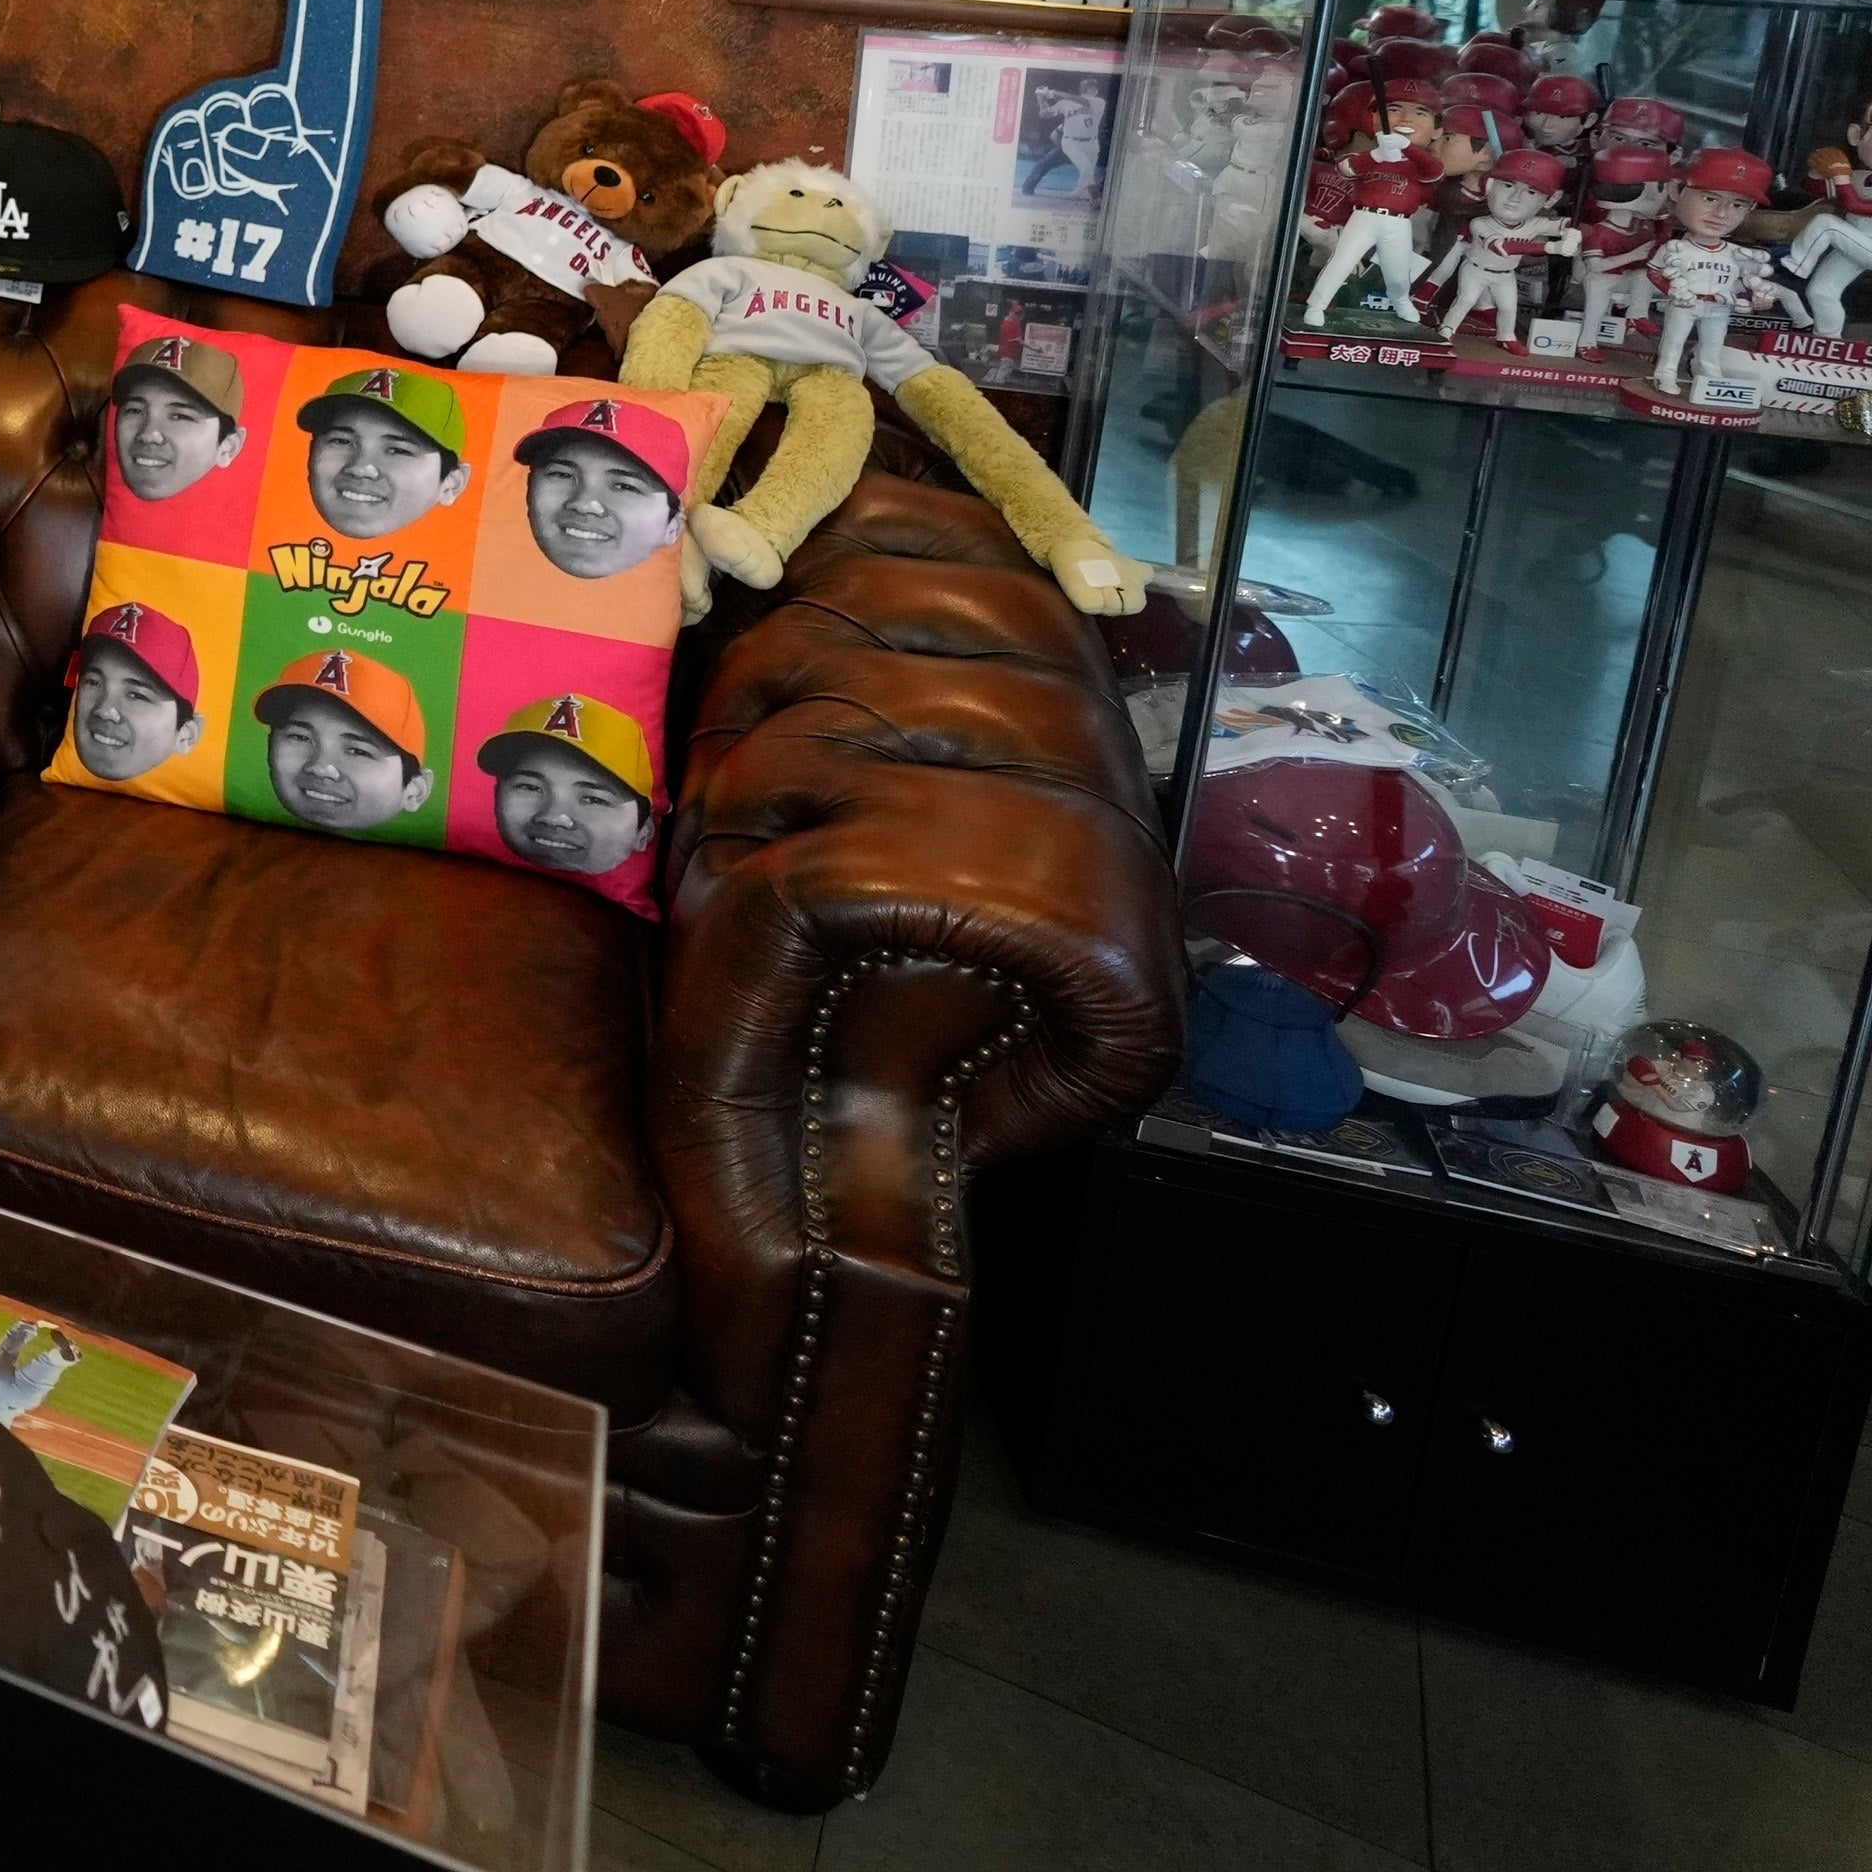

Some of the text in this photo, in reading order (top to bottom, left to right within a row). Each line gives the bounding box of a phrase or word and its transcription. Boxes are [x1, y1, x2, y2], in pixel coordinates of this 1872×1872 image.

[1310, 187, 1343, 215] 17
[515, 195, 613, 262] ANGELS
[175, 217, 283, 284] #17
[1686, 262, 1732, 276] ANGELS
[1716, 273, 1730, 285] 17
[742, 286, 859, 342] ANGELS
[1329, 343, 1421, 367] 大谷 翔平
[1499, 367, 1559, 382] SHOHEI
[1777, 377, 1826, 397] SHOHEI
[1705, 385, 1742, 404] JAE
[1650, 405, 1717, 426] SHOHEI
[266, 537, 452, 618] Ninjala
[336, 620, 394, 647] GungHo
[215, 1484, 342, 1540] 王座奪還。
[198, 1500, 340, 1559] 14年ぶりの
[193, 1587, 332, 1649] 栗山英樹
